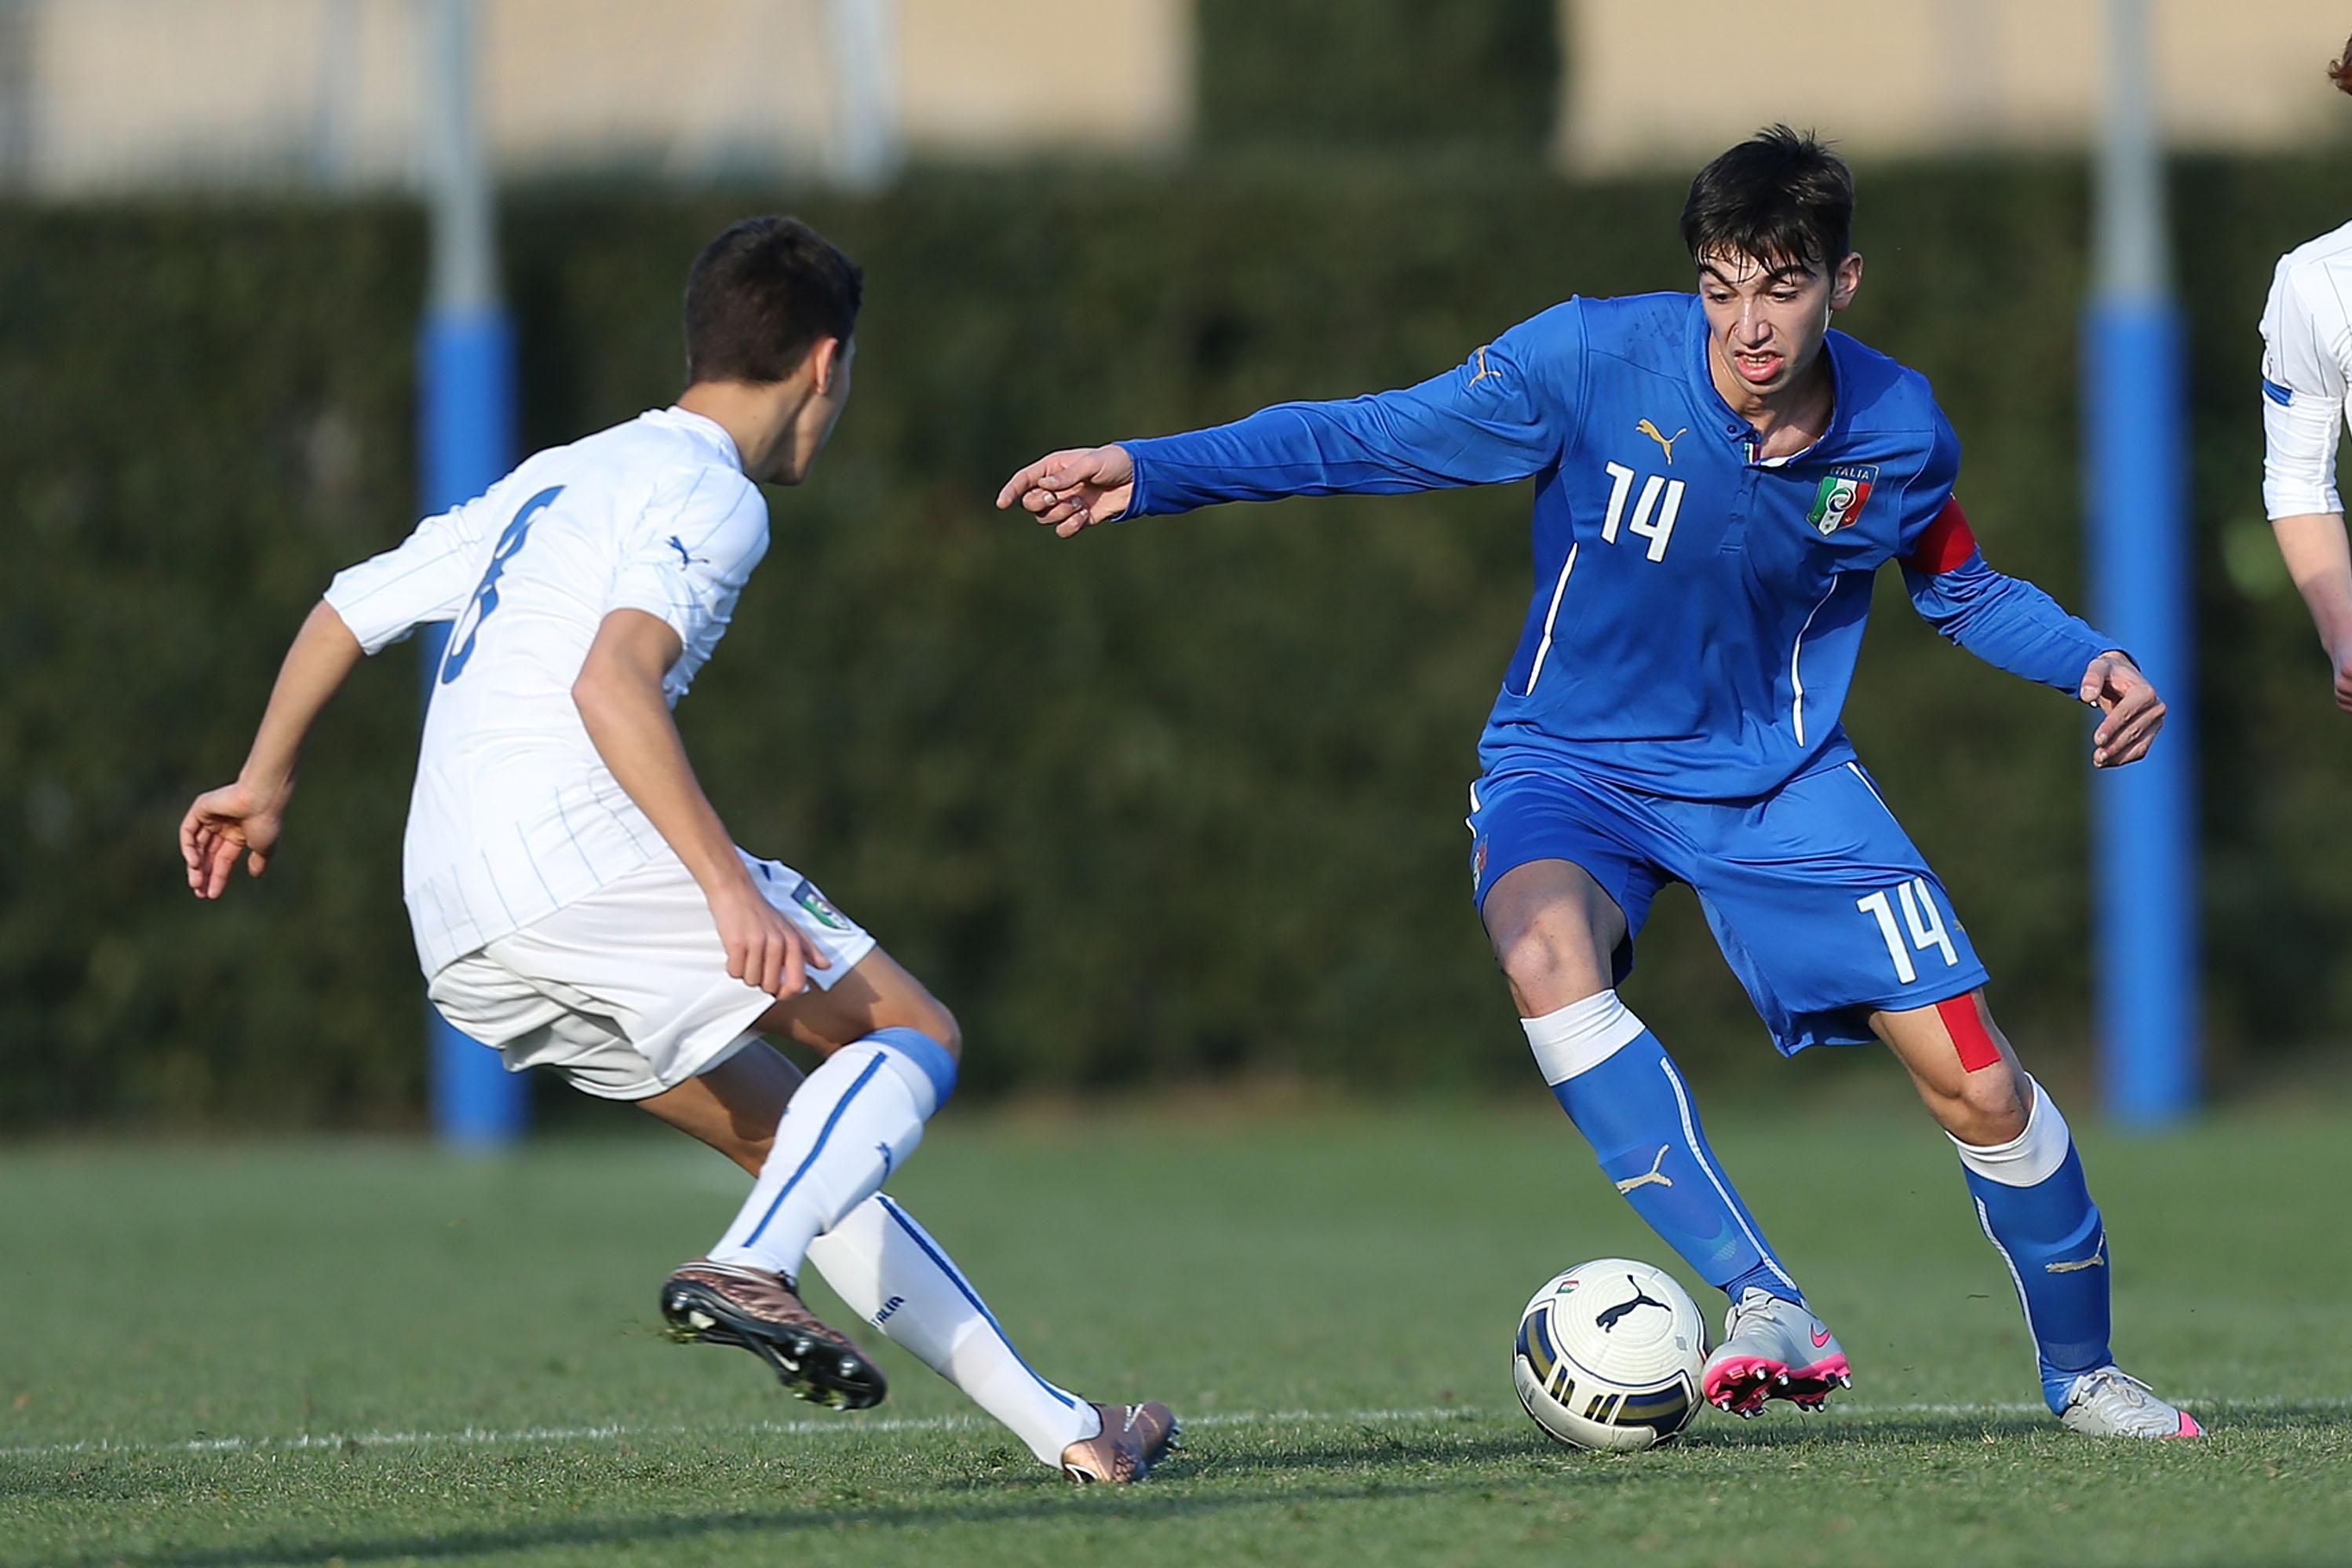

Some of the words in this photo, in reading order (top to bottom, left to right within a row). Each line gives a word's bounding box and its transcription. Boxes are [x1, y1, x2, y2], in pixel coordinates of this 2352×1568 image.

[1603, 461, 1686, 562] 14
[1829, 465, 1870, 480] ITALIA
[441, 485, 567, 684] 8
[1857, 877, 1959, 984] 14
